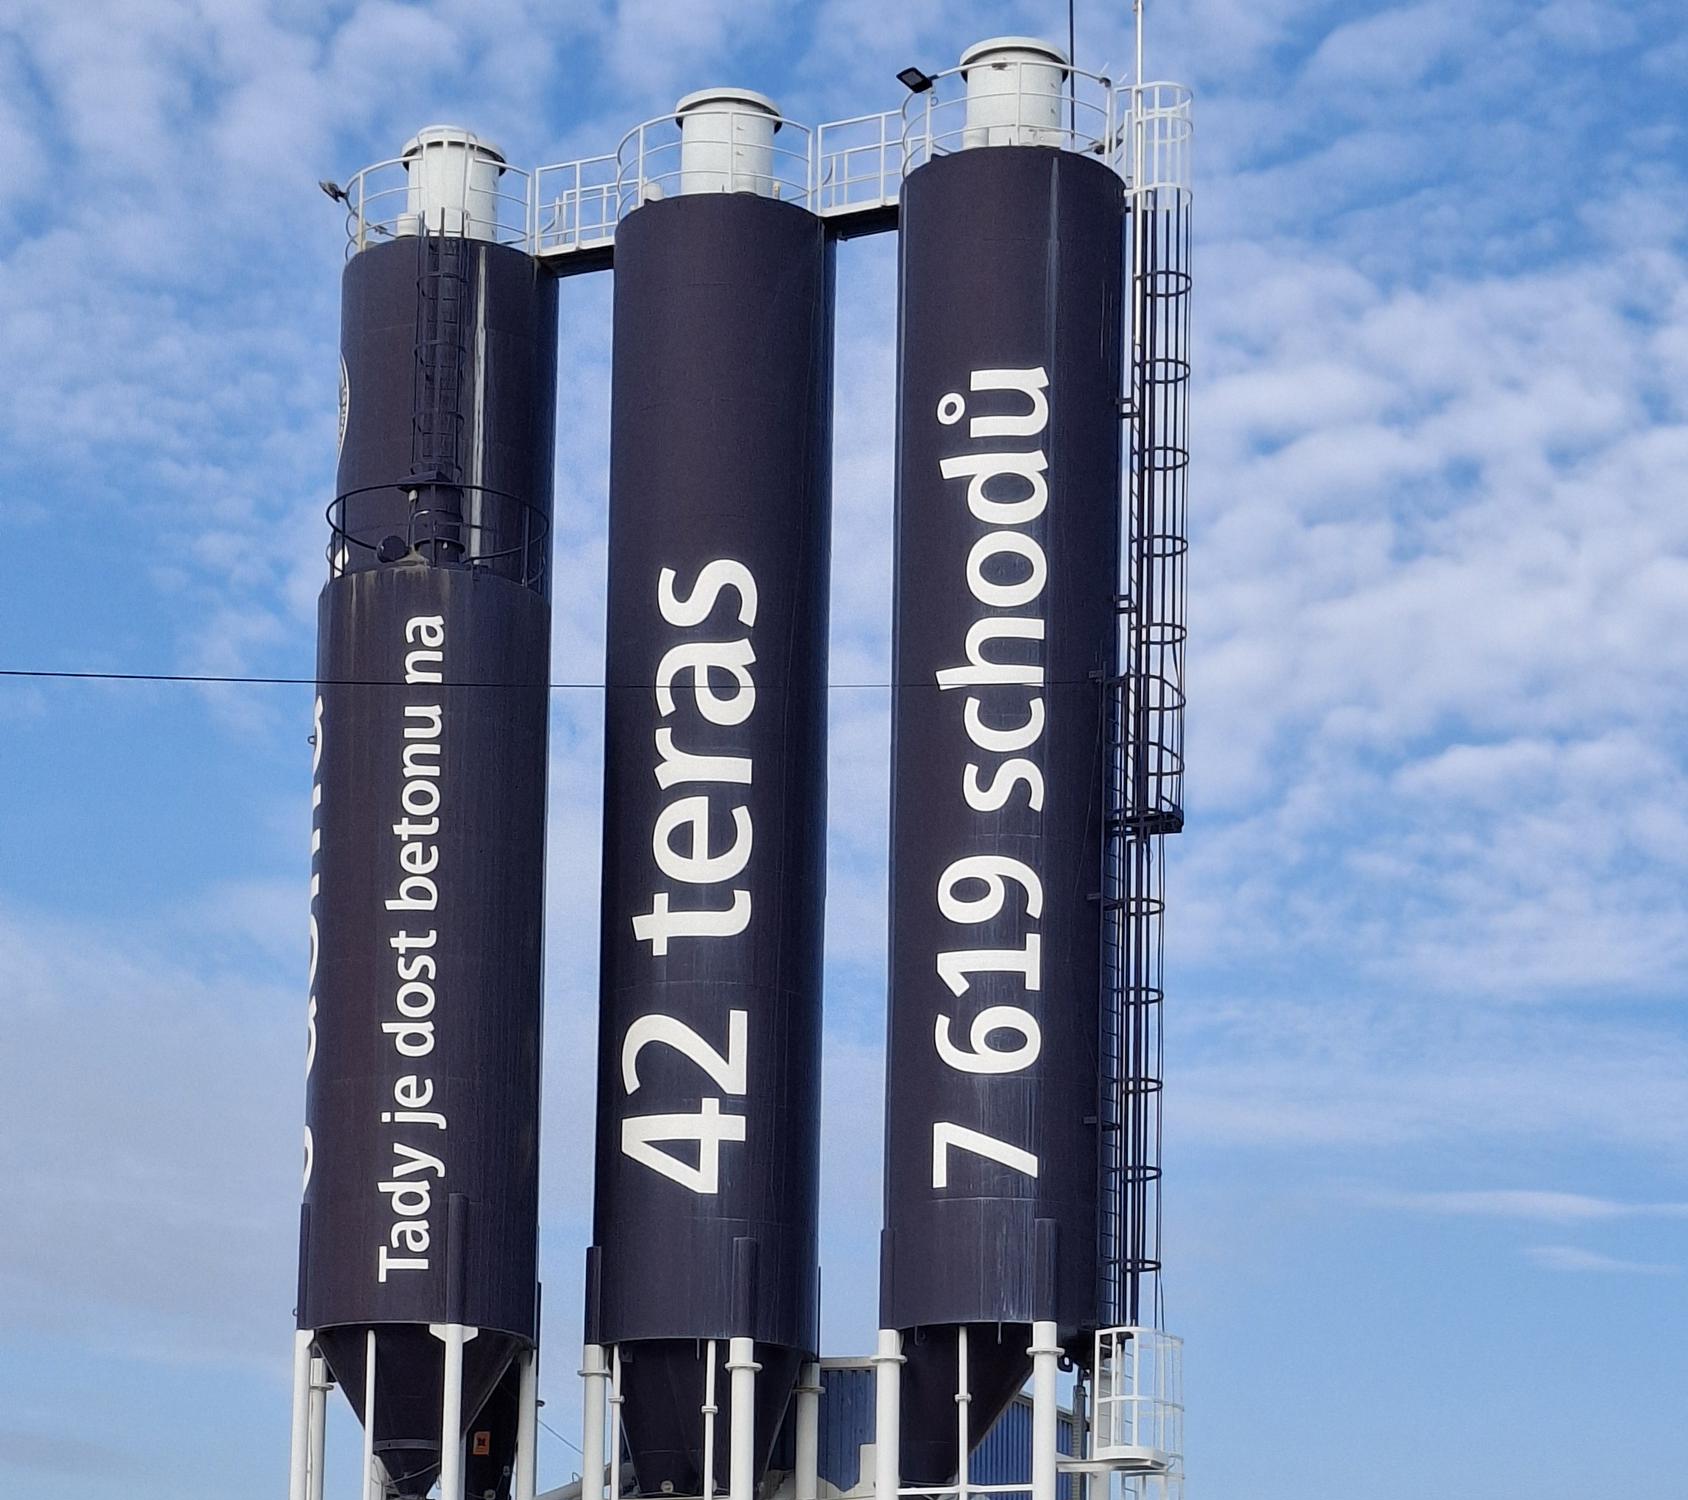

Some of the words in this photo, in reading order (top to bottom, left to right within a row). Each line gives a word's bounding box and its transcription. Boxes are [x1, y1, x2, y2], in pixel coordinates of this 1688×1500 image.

[404, 615, 445, 684] na
[935, 366, 1050, 812] schodů
[384, 704, 442, 911] betonu
[631, 559, 758, 957] teras
[381, 929, 437, 1057] dost
[934, 855, 1044, 1074] 619
[381, 1076, 447, 1130] je
[621, 1009, 748, 1194] 42
[932, 1121, 1038, 1189] 7
[377, 1142, 446, 1283] Tady
